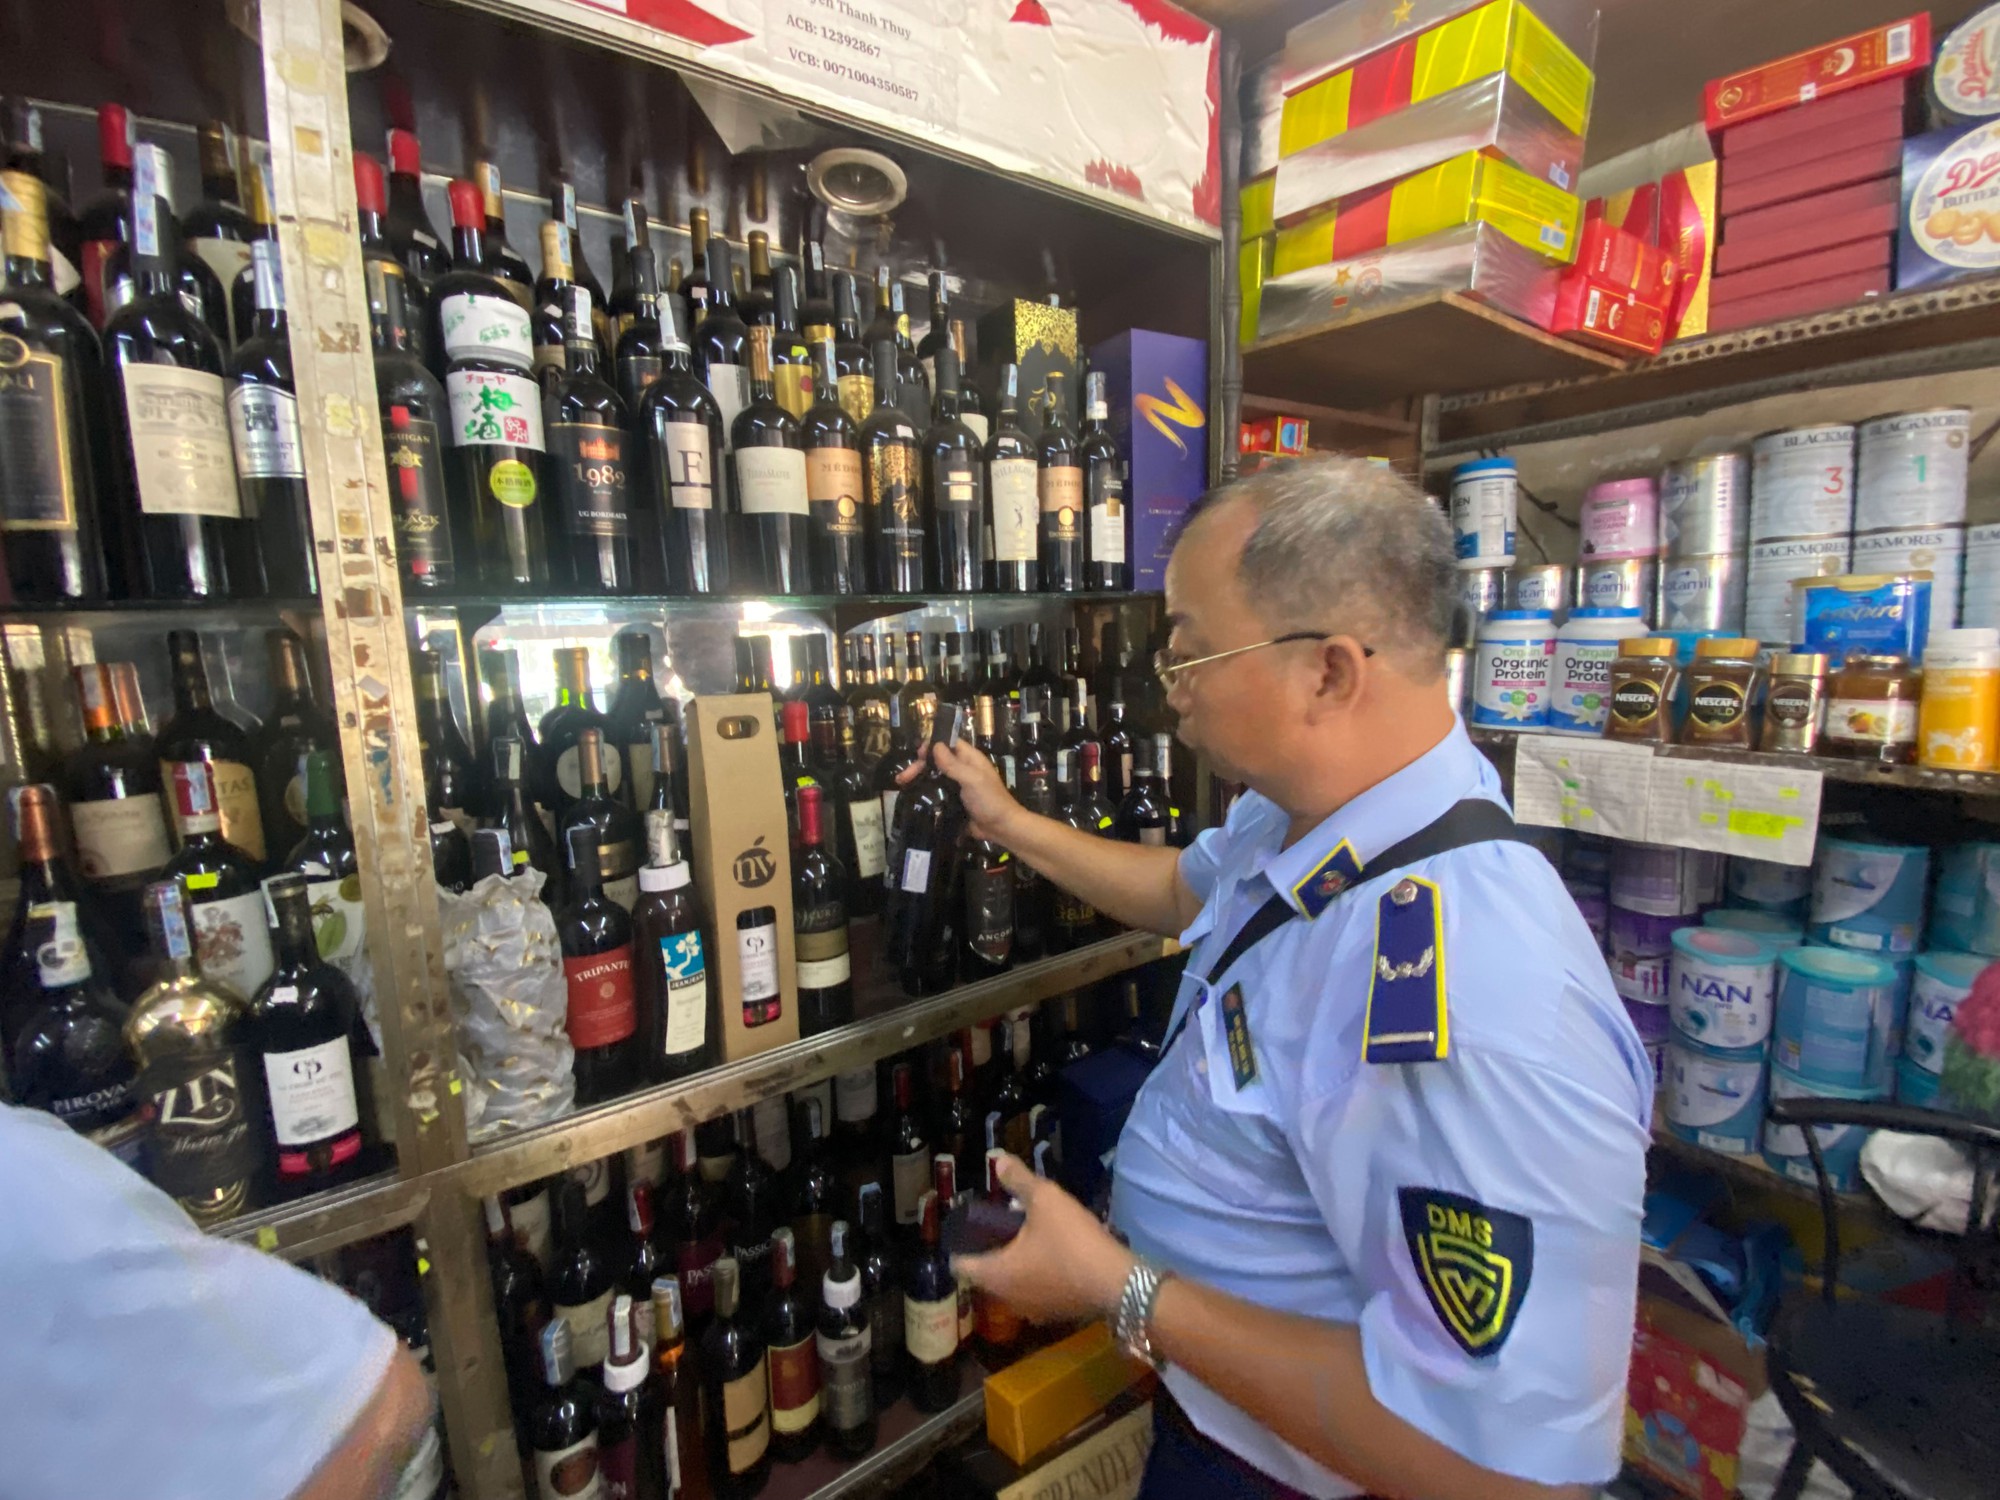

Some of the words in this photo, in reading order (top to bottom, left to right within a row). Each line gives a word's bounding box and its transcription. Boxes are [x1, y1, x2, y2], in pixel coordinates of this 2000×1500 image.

[838, 0, 877, 27] Thanh
[880, 17, 912, 41] Thuy
[786, 14, 818, 36] ACB:
[821, 26, 881, 59] 12392867
[788, 47, 821, 69] VCB:
[823, 59, 920, 102] 0071004350587
[573, 463, 627, 490] 1982
[1823, 466, 1845, 495] 3
[1911, 454, 1928, 483] 1
[1491, 657, 1549, 671] Organic
[1495, 668, 1545, 679] Protein
[1681, 972, 1753, 1006] NAN
[1426, 1202, 1494, 1249] DMS
